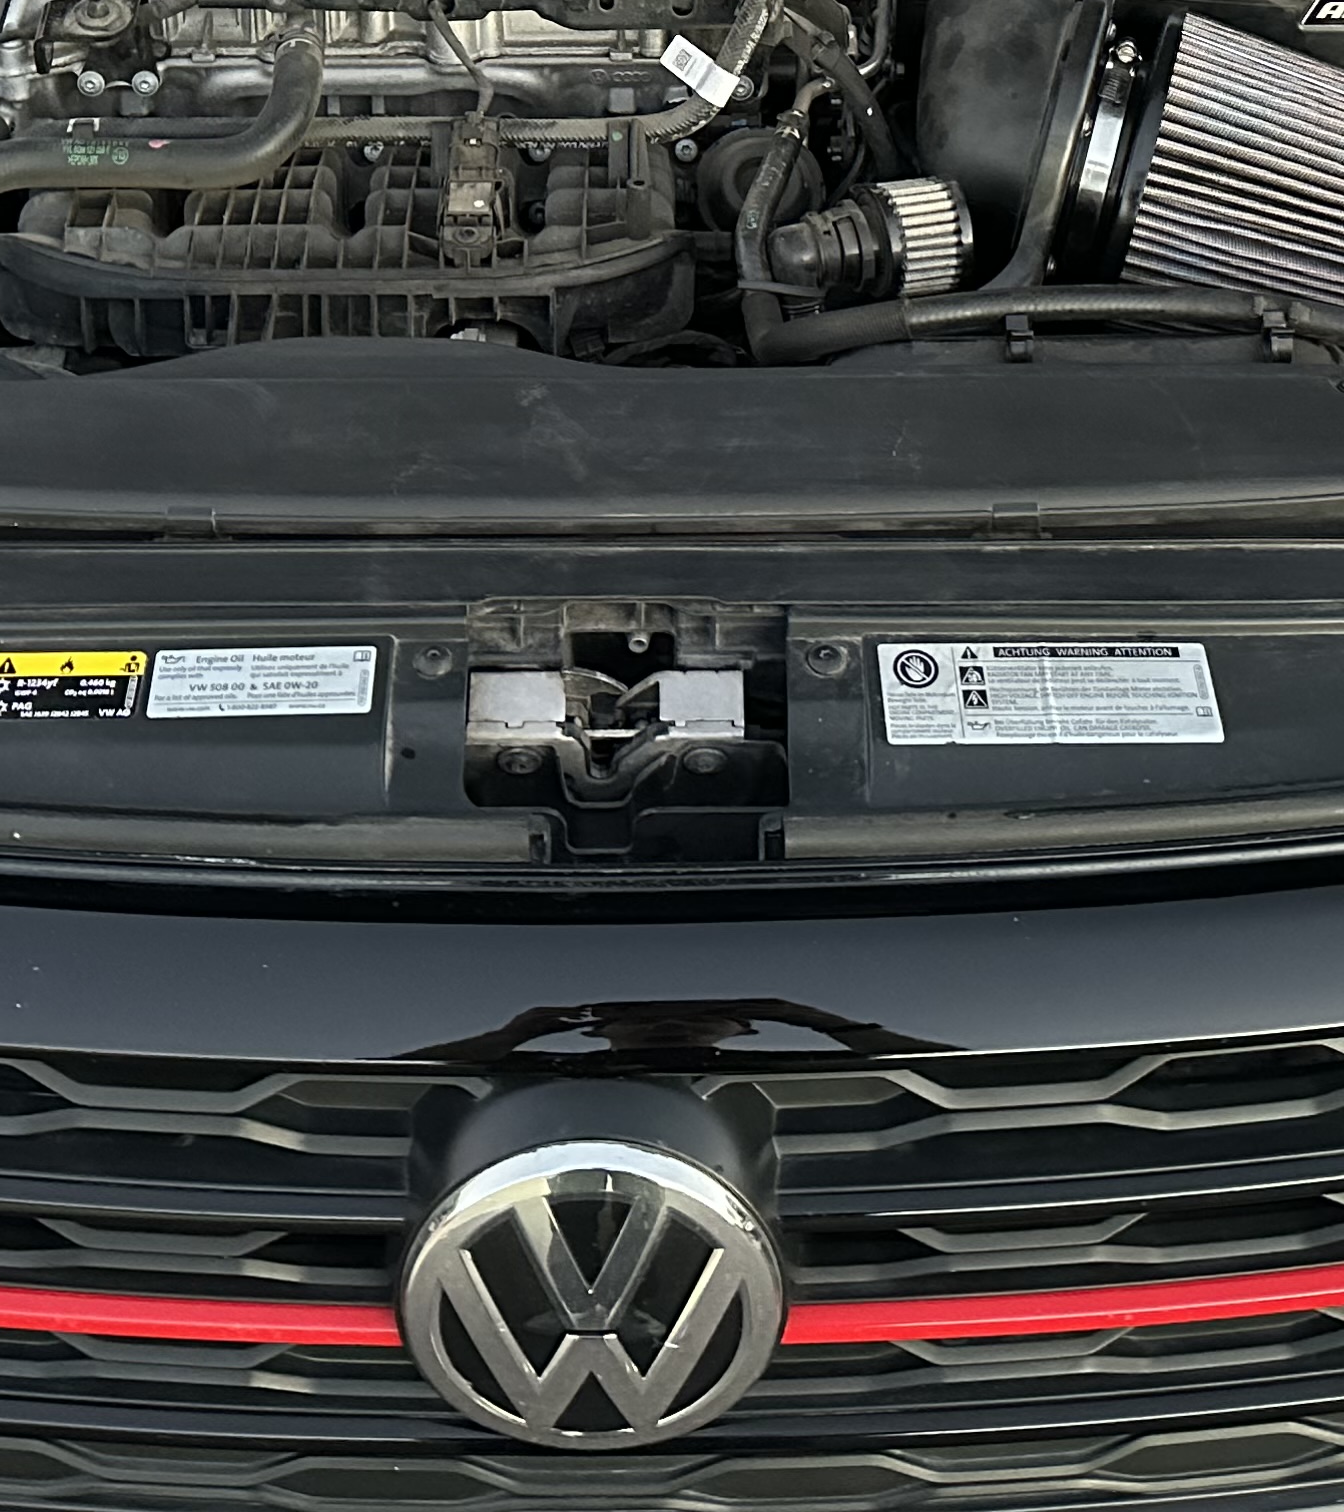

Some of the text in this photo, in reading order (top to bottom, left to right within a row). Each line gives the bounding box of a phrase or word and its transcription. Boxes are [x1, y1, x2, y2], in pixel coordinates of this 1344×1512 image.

[998, 647, 1172, 657] ACHTUNG WARNING ATTENTION
[196, 654, 245, 666] Engine Oil
[253, 654, 277, 662] Huile
[16, 678, 59, 690] R-1234yf
[105, 678, 117, 689] kg
[189, 681, 319, 692] VW 508 00 & SAE 0W-20
[11, 701, 33, 711] PAG
[98, 708, 115, 717] VW
